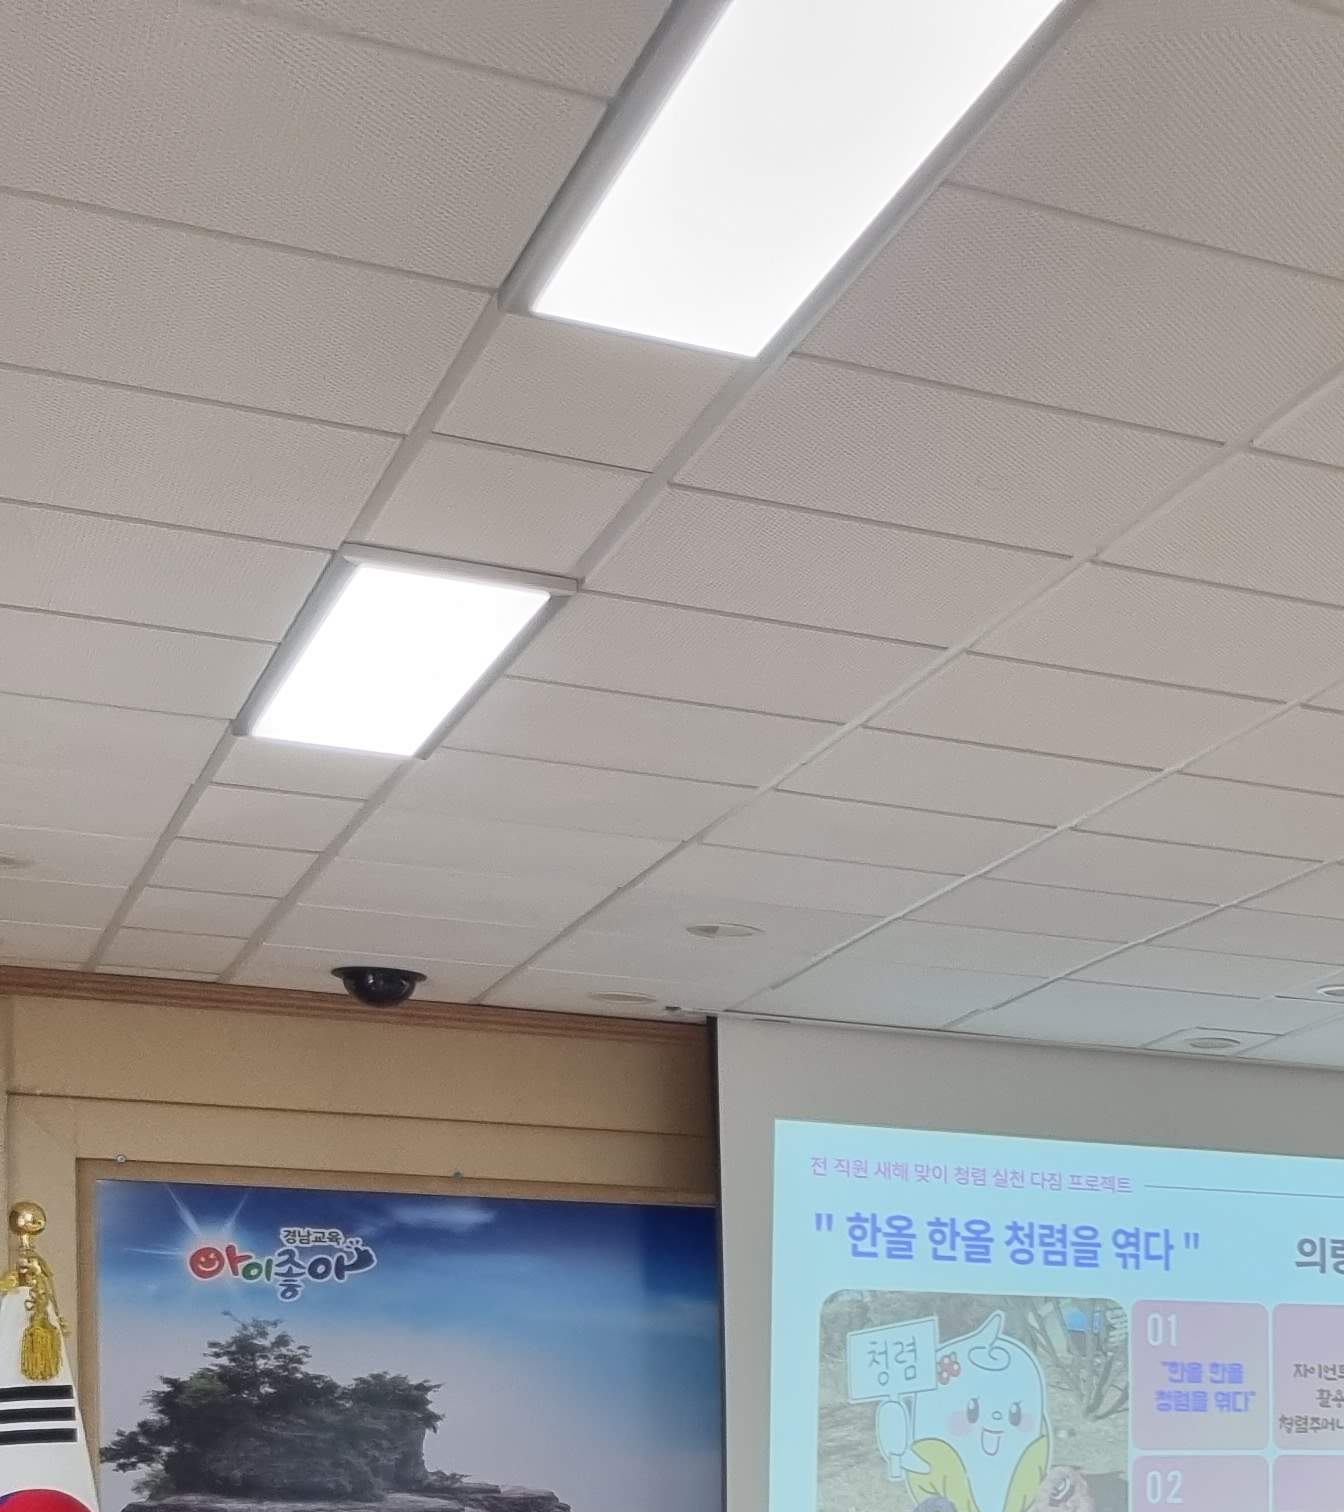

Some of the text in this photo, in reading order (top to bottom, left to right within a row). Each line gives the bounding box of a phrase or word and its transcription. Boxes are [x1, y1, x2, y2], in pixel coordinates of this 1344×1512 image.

[811, 1156, 1133, 1194] 전 직원 새해 맞이 청렴 실천 다짐 프로젝트
[282, 1229, 342, 1246] 경남교육
[846, 1211, 917, 1260] 한올
[926, 1216, 994, 1264] 한올
[1004, 1220, 1102, 1268] 청렴을
[1111, 1225, 1175, 1272] 엮다
[189, 1244, 376, 1300] 아이좋아
[1146, 1312, 1178, 1347] 01
[867, 1335, 918, 1386] 청렴
[1146, 1470, 1184, 1504] 02
